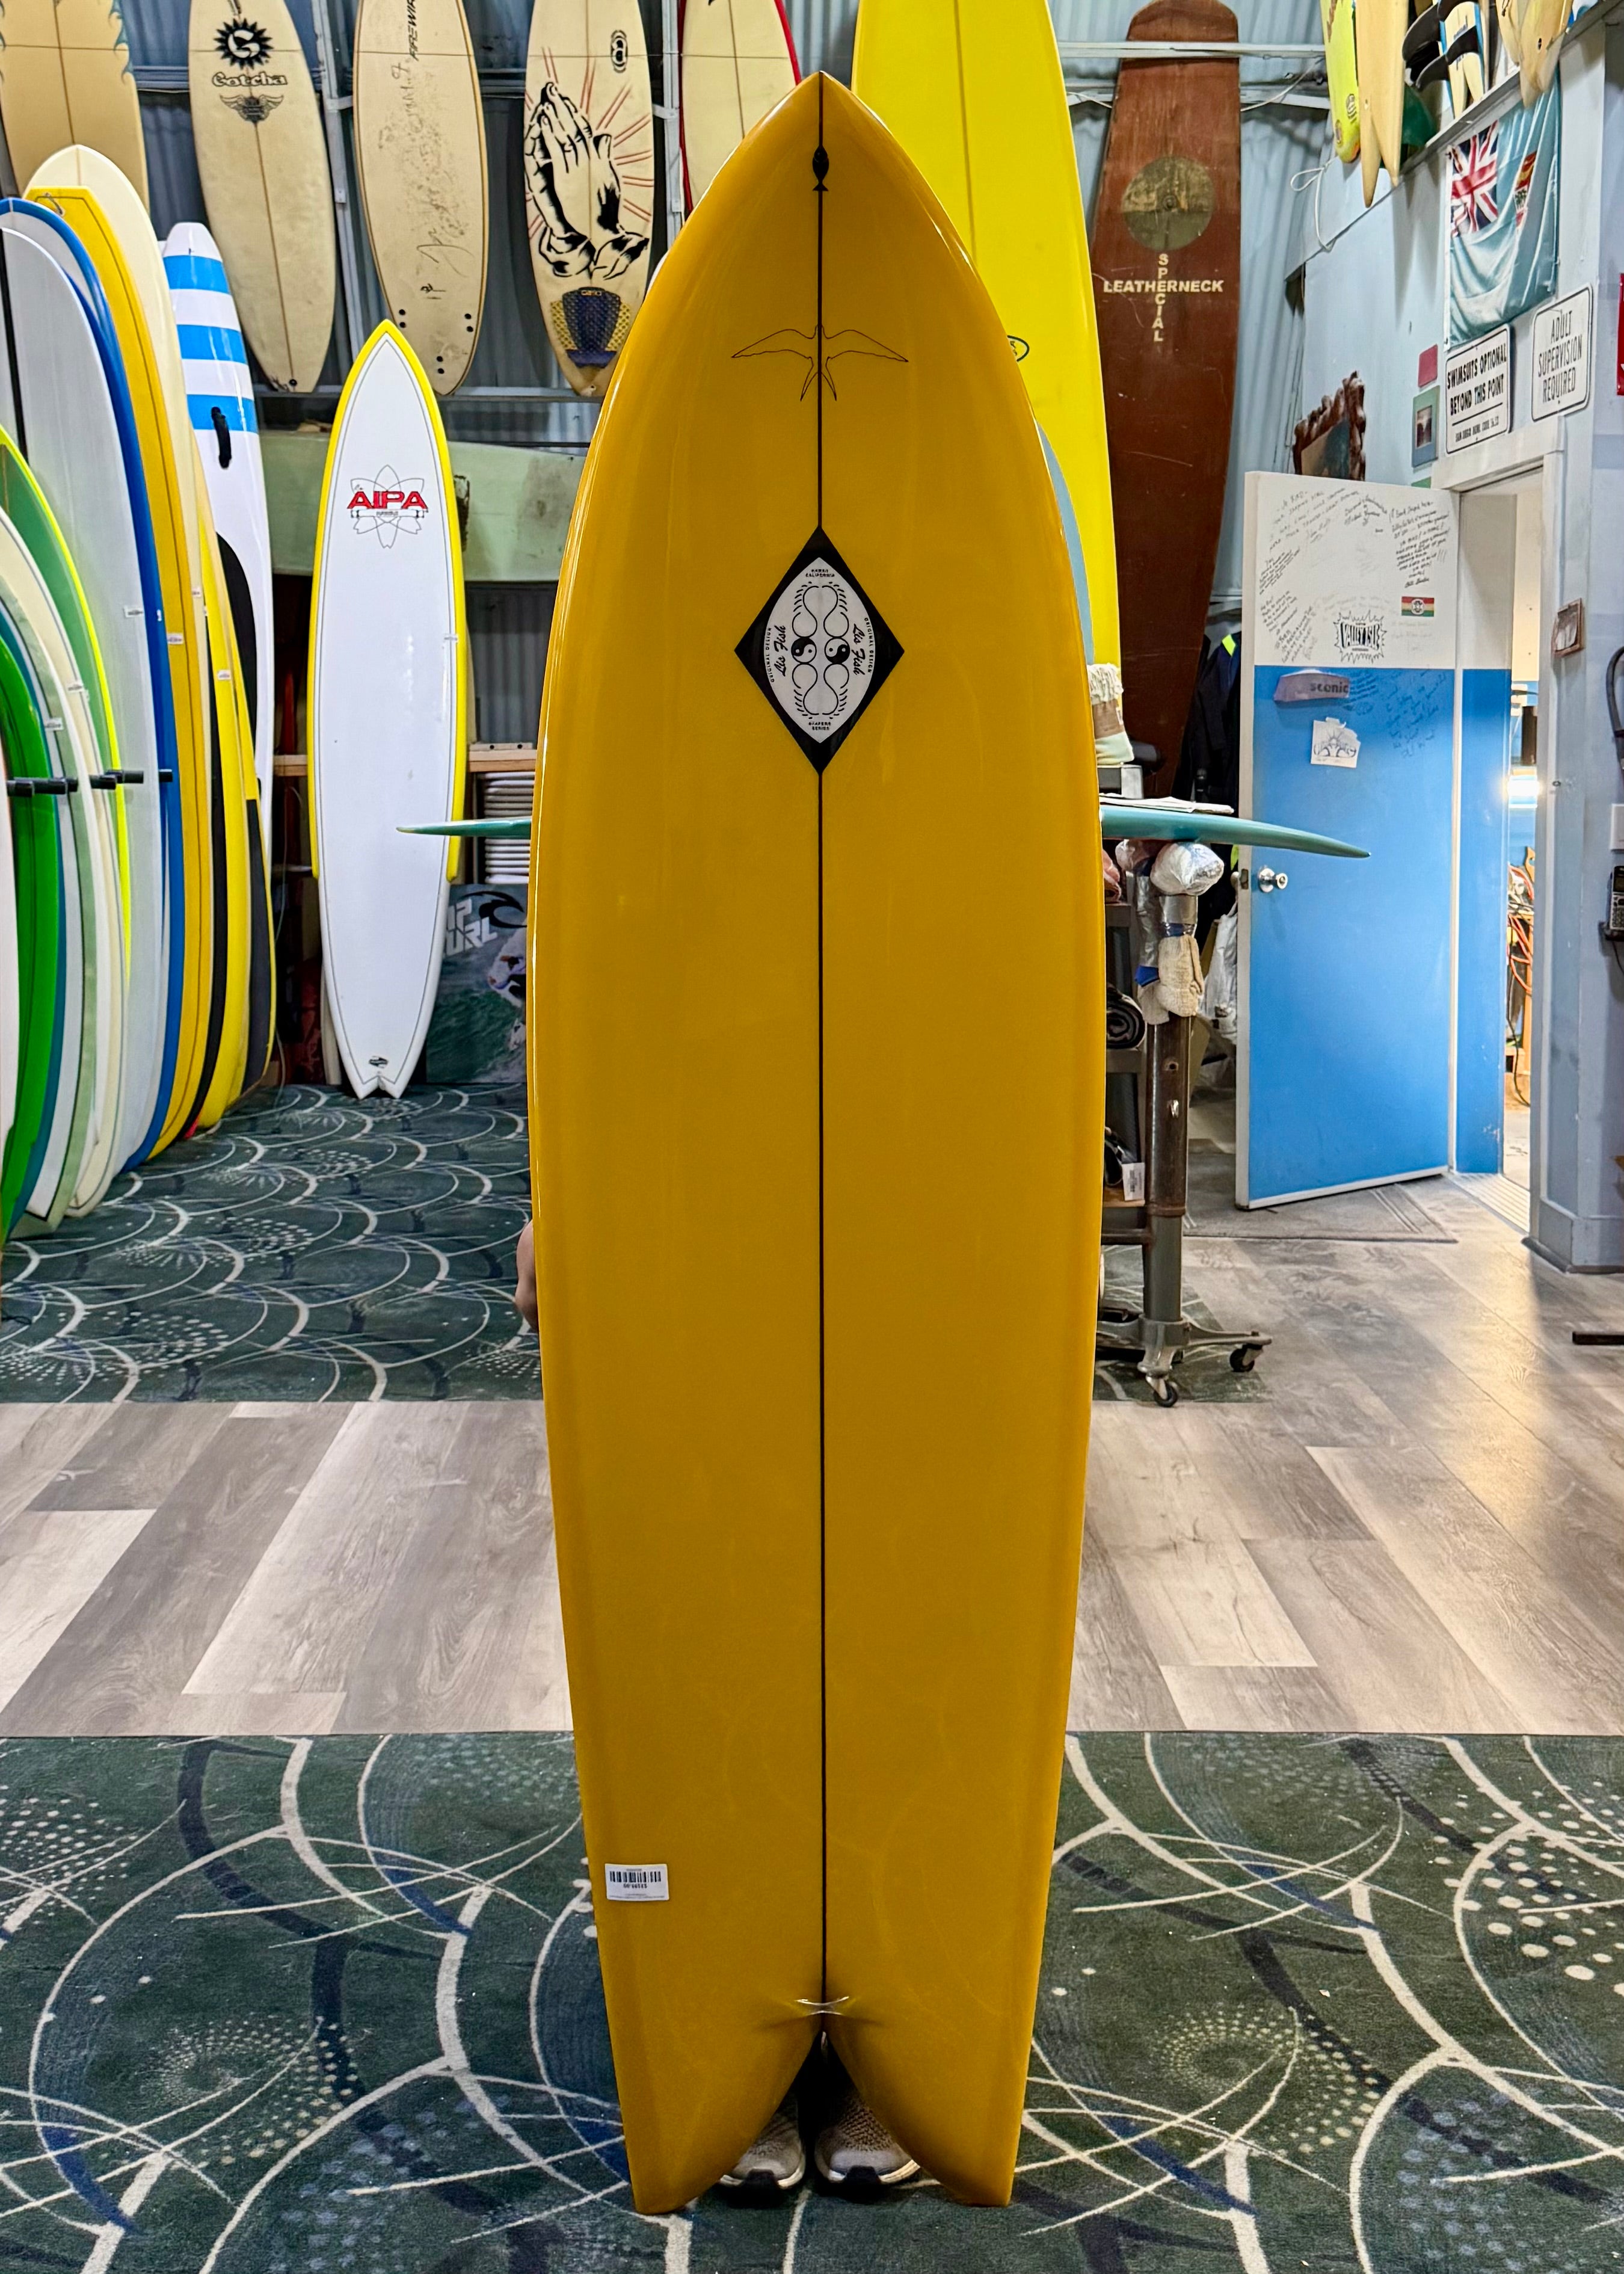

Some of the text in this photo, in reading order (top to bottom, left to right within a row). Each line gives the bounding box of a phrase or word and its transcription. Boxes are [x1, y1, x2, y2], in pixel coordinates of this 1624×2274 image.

[407, 0, 419, 61] FIREWIR
[1103, 280, 1224, 292] LEATHERNECK
[1151, 253, 1169, 342] SPECIAL
[1550, 310, 1572, 344] ADULT
[1447, 343, 1507, 389] SWIMSUITS OPTIONAL
[1538, 333, 1582, 378] SUPERVISION
[1450, 374, 1504, 416] BEYOND THIS POINT
[1542, 366, 1576, 403] REQUIRED
[346, 490, 429, 510] AIPA
[774, 625, 789, 677] Lis Fish
[851, 623, 866, 675] Lis Fish
[447, 898, 472, 930] IP
[446, 917, 497, 956] URL
